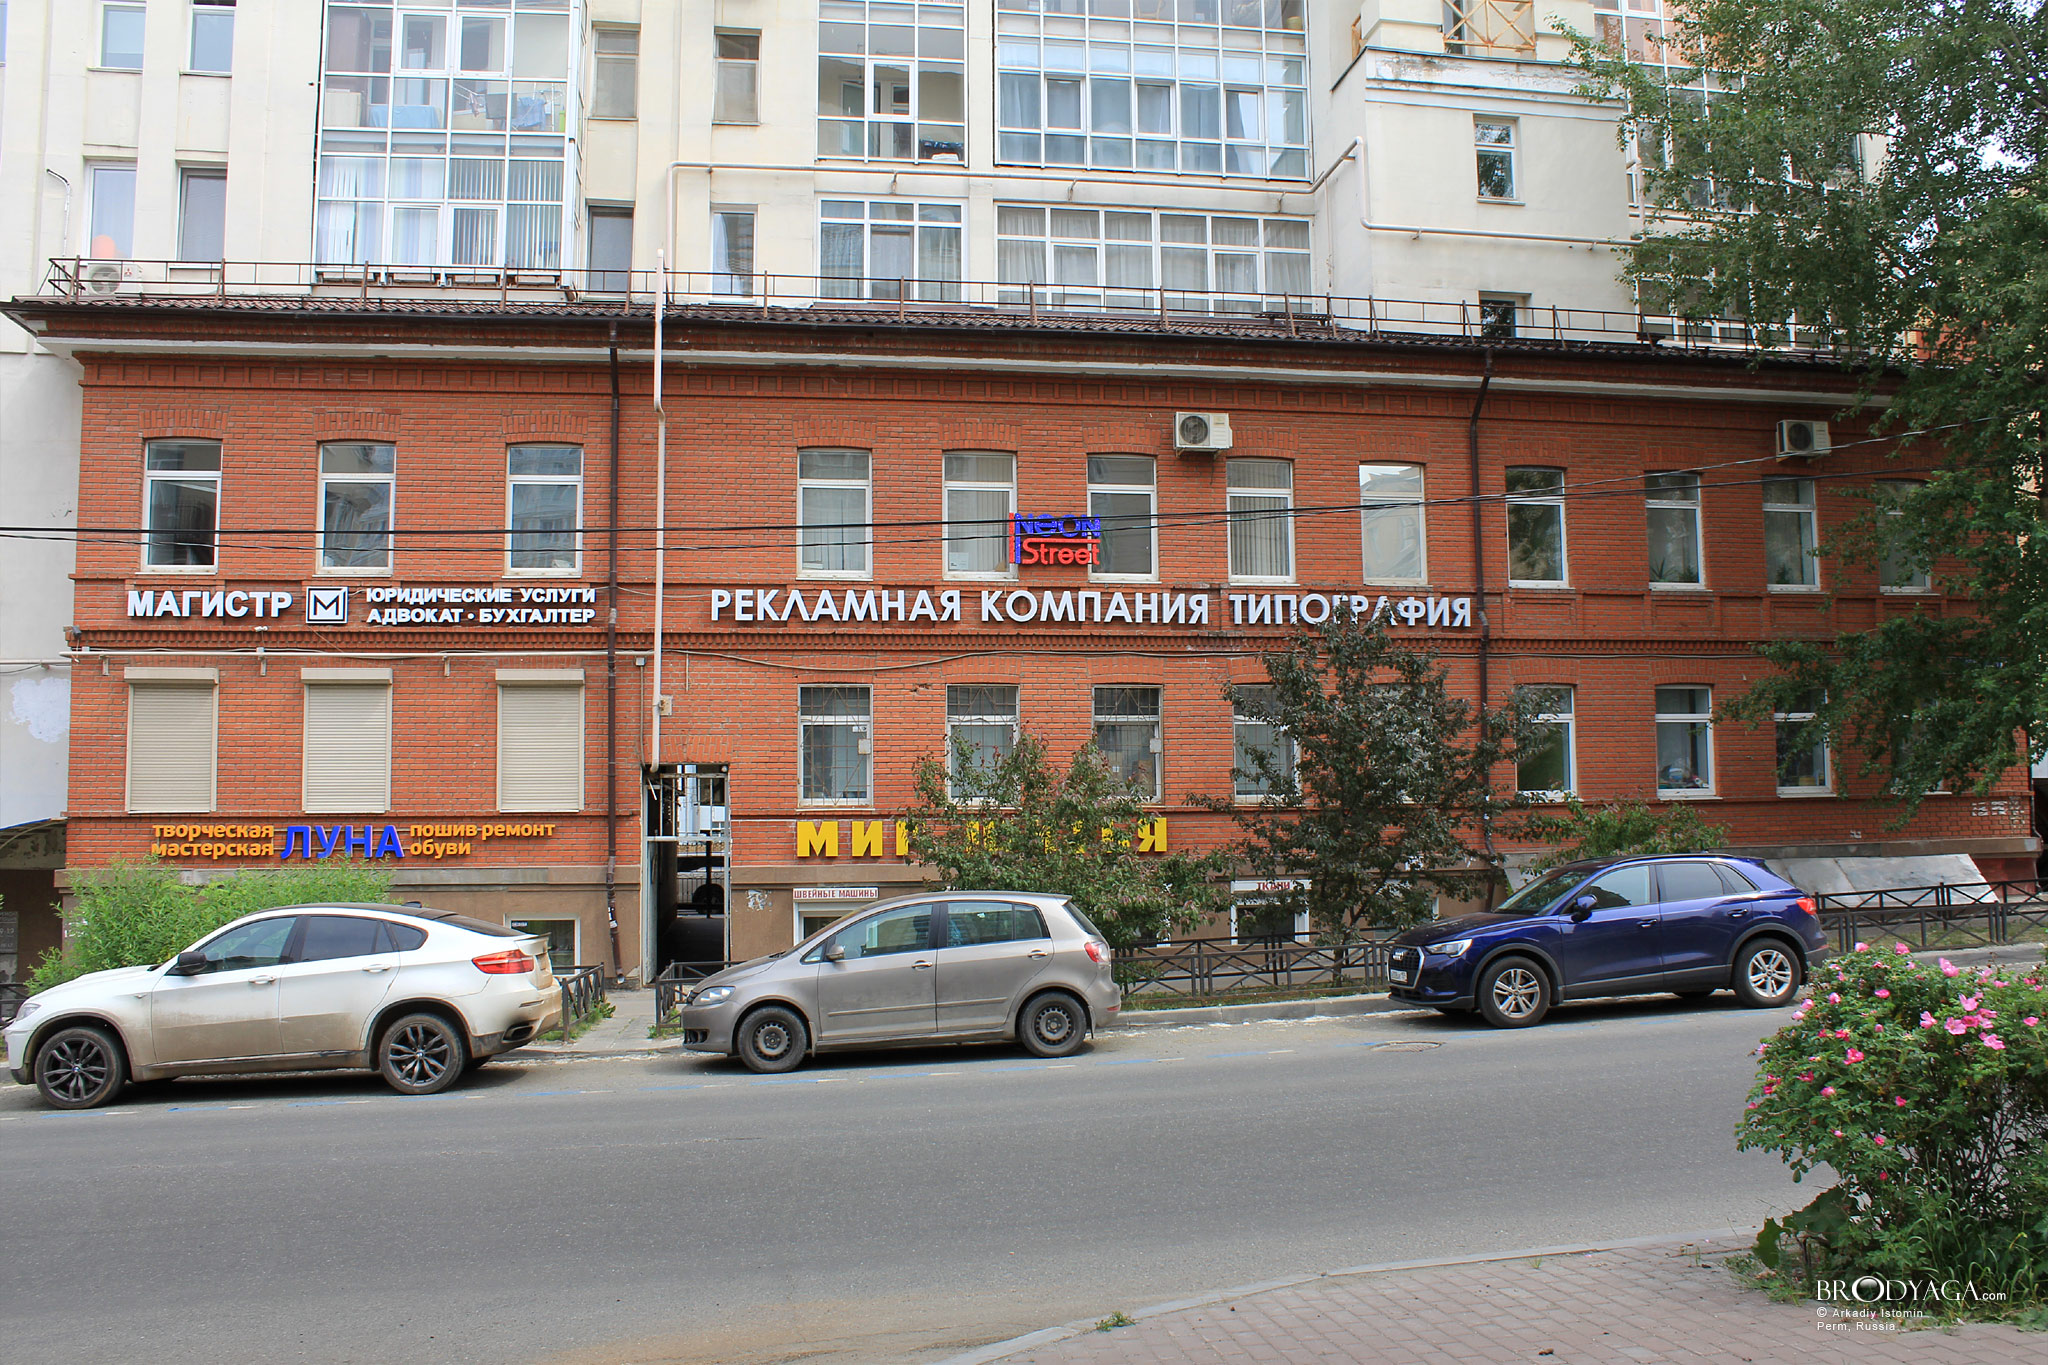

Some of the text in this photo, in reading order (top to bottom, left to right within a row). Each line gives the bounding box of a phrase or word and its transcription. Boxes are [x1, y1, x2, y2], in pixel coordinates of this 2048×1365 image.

[1022, 538, 1101, 565] Street
[128, 591, 292, 617] МАГИСТР
[366, 588, 596, 604] ЮРИДИЧЕСКИЕ УСЛУГИ
[711, 589, 961, 621] РЕКЛАМНАЯ
[981, 590, 1209, 624] КОМПАНИЯ
[367, 608, 597, 625] АДВОКАТ БУХГАЛТЕР
[152, 825, 275, 842] творческая
[410, 823, 556, 840] пошив ремонт
[280, 825, 406, 859] ЛУНА
[410, 840, 472, 858] обуви
[151, 843, 275, 860] мастерская
[794, 889, 878, 899] ШВЕЙНЫЕ МАШИНЫ
